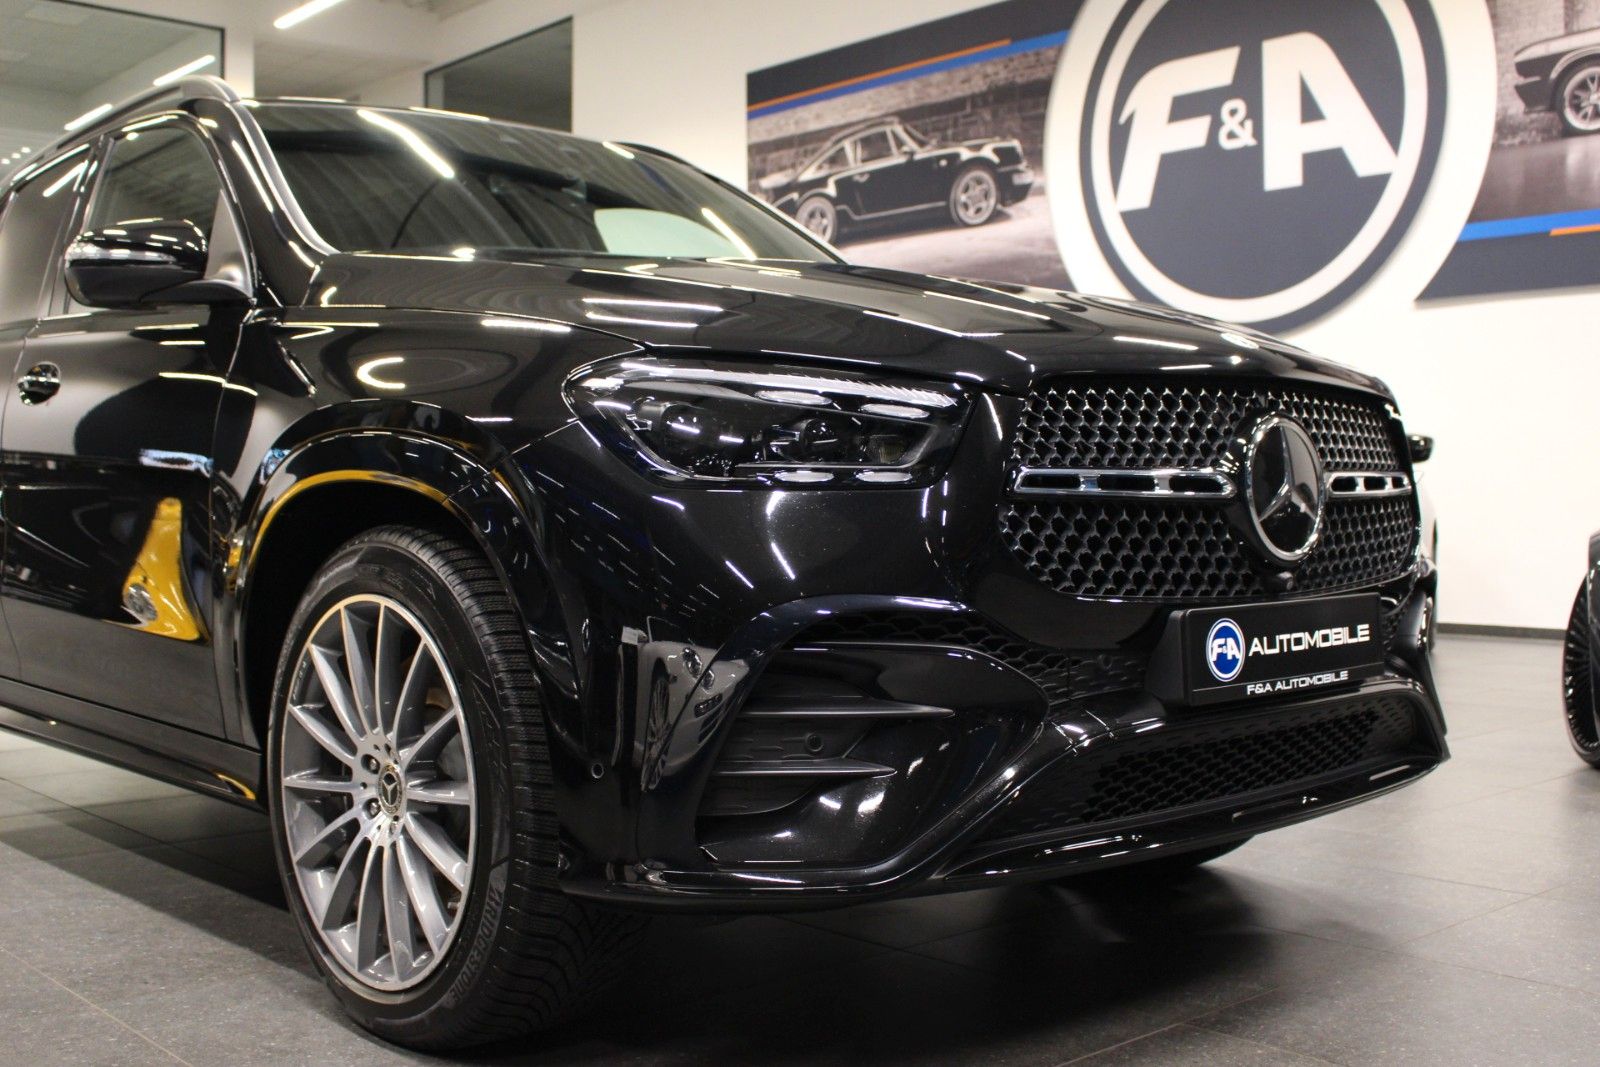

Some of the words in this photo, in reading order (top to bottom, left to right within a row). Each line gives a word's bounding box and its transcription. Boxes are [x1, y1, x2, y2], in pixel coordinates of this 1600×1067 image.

[1116, 31, 1399, 213] F&A
[1248, 624, 1370, 656] AUTOMOBILE
[1246, 684, 1273, 695] F&A
[1275, 670, 1349, 691] AUTOMOBILE
